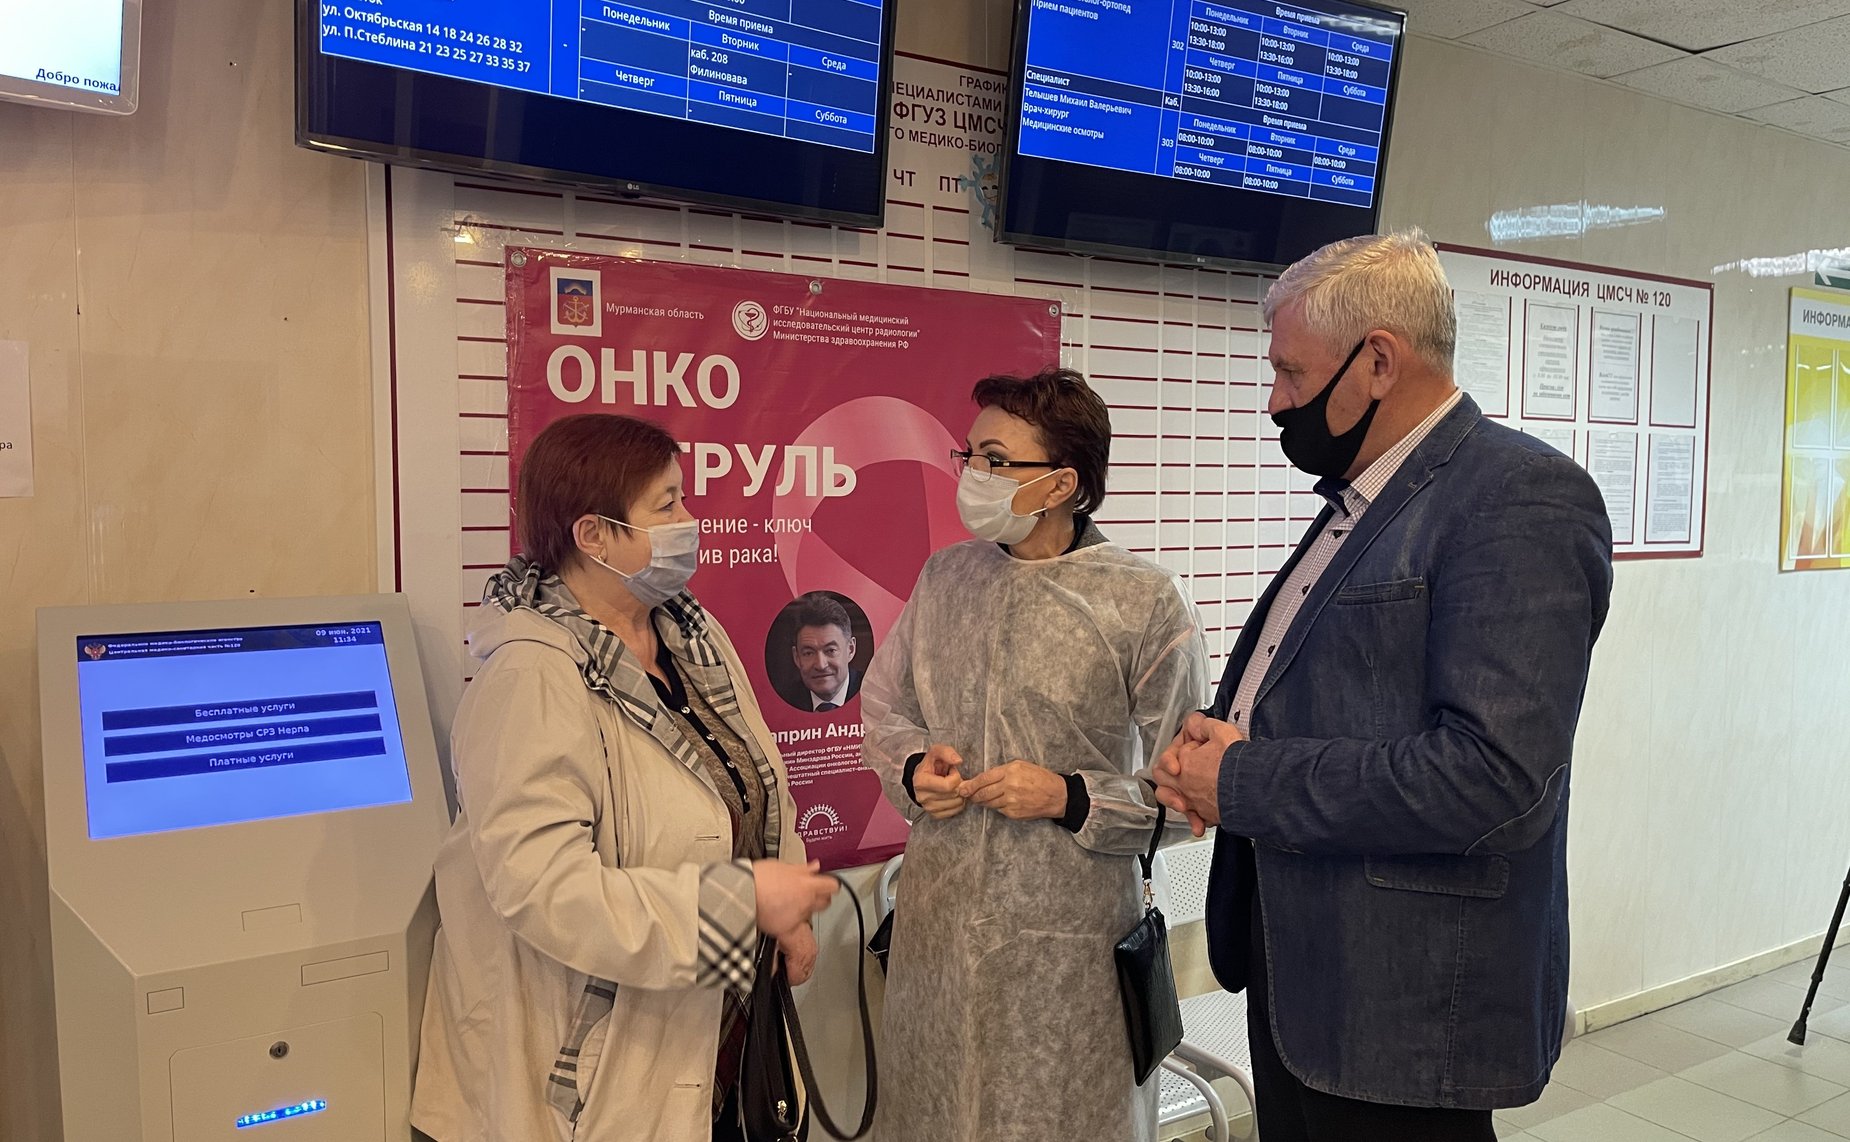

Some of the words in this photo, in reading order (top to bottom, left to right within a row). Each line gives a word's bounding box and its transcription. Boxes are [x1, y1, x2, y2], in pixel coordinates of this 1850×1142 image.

[603, 6, 670, 31] Понедельник
[1060, 5, 1099, 20] пациентов
[1205, 7, 1249, 25] Понедельник
[1276, 6, 1297, 21] Время
[1297, 12, 1320, 25] приема
[323, 4, 340, 16] ул.
[344, 7, 422, 32] Октябрьская
[426, 23, 440, 37] 14
[443, 27, 457, 40] 18
[460, 31, 474, 43] 24
[476, 34, 491, 47] 26
[493, 37, 507, 50] 28
[509, 40, 523, 53] 32
[708, 9, 738, 26] Время
[740, 18, 774, 34] приема
[1191, 21, 1227, 37] 10:00-13:00
[1283, 25, 1309, 39] Вторник
[323, 24, 341, 36] ул.
[344, 26, 416, 51] П.Стеблина
[419, 41, 432, 54] 21
[436, 44, 450, 57] 23
[453, 48, 467, 60] 25
[469, 51, 483, 64] 27
[486, 54, 499, 67] 33
[501, 57, 515, 70] 35
[517, 60, 531, 73] 37
[722, 33, 759, 51] Вторник
[1171, 40, 1185, 51] 302
[1189, 35, 1225, 51] 13:30-18:00
[1261, 37, 1295, 52] 10:00-13:00
[1351, 41, 1370, 53] Среда
[691, 48, 709, 62] каб.
[711, 51, 728, 65] 208
[821, 56, 847, 71] Среда
[1209, 56, 1236, 70] Четверг
[1259, 50, 1294, 66] 13:30-16:00
[1328, 52, 1360, 67] 10:00-13:00
[36, 68, 80, 85] Добро
[615, 70, 655, 88] Четверг
[690, 64, 748, 86] Филиновава
[1026, 69, 1070, 86] Специалист
[1185, 69, 1222, 84] 10:00-13:00
[1277, 71, 1304, 85] Пятница
[1326, 65, 1358, 80] 13:30-18:00
[1184, 82, 1220, 98] 13:30-16:00
[1256, 83, 1290, 98] 10:00-13:00
[1343, 85, 1367, 98] Суббота
[718, 90, 757, 108] Пятница
[1025, 87, 1059, 102] Телышев
[1059, 94, 1088, 108] Михаил
[1089, 100, 1132, 115] Валерьевич
[1165, 95, 1180, 107] Каб.
[1254, 96, 1288, 111] 13:30-18:00
[815, 109, 847, 125] Суббота
[893, 101, 947, 126] ФГУЗ
[1023, 102, 1070, 119] Врач-хирург
[1022, 117, 1072, 134] Медицинские
[1073, 125, 1104, 140] осмотры
[1193, 118, 1236, 134] Понедельник
[1263, 115, 1285, 128] Время
[1286, 120, 1307, 132] приема
[1161, 137, 1174, 148] 303
[1178, 132, 1215, 147] 08:00-10:00
[1270, 131, 1296, 145] Вторник
[1248, 144, 1283, 159] 08:00-10:00
[1338, 144, 1356, 157] Среда
[1198, 152, 1225, 166] Четверг
[1313, 155, 1346, 170] 08:00-10:00
[893, 168, 916, 187] ЧТ
[1174, 165, 1211, 180] 08:00-10:00
[1266, 164, 1292, 177] Пятница
[939, 175, 962, 193] ПТ
[1244, 176, 1279, 190] 08:00-10:00
[1331, 174, 1354, 187] Суббота
[1490, 269, 1590, 299] ИНФОРМАЦИЯ
[1597, 283, 1632, 303] ЦМСЧ
[1636, 288, 1649, 304] №
[1652, 290, 1671, 308] 120
[606, 302, 665, 316] Мурманская
[667, 307, 705, 320] область
[772, 304, 794, 316] ФГБУ
[796, 306, 858, 322] "Национальный
[859, 313, 909, 326] медицинский
[773, 319, 850, 334] исследовательский
[851, 325, 874, 336] центр
[875, 327, 920, 339] радиологии"
[773, 330, 829, 344] Министерства
[830, 335, 896, 349] здравоохранения
[897, 340, 909, 349] РФ
[546, 344, 741, 409] ОНКО
[696, 518, 748, 534] ение
[764, 518, 812, 534] ключ
[729, 544, 779, 569] рака!
[350, 626, 371, 635] 2021
[194, 705, 259, 718] Бесплатные
[260, 702, 296, 714] услуги
[185, 730, 254, 744] Медосмотры
[277, 725, 310, 736] Нерпа
[208, 755, 257, 767] Платные
[258, 751, 295, 764] услуги
[797, 748, 825, 757] директор
